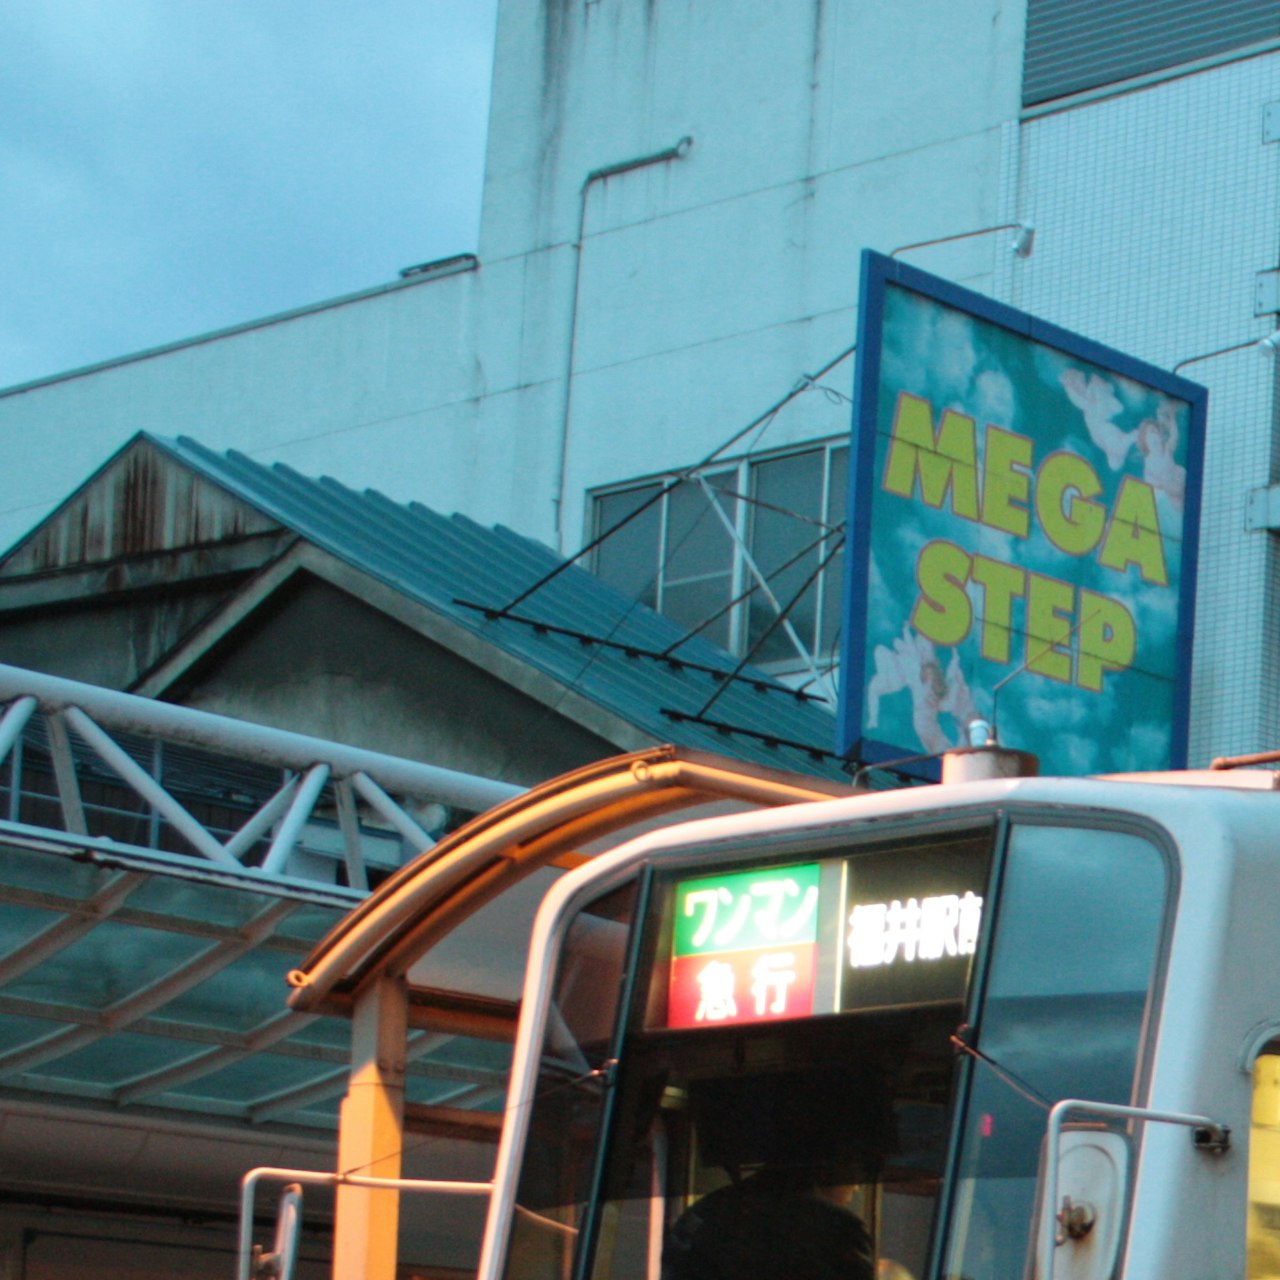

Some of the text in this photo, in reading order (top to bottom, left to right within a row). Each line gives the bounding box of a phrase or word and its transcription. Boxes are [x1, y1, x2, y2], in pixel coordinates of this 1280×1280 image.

[881, 389, 1170, 587] MEGA
[910, 538, 1137, 693] STEP
[684, 878, 820, 947] ワンマン
[694, 952, 797, 1021] 急行
